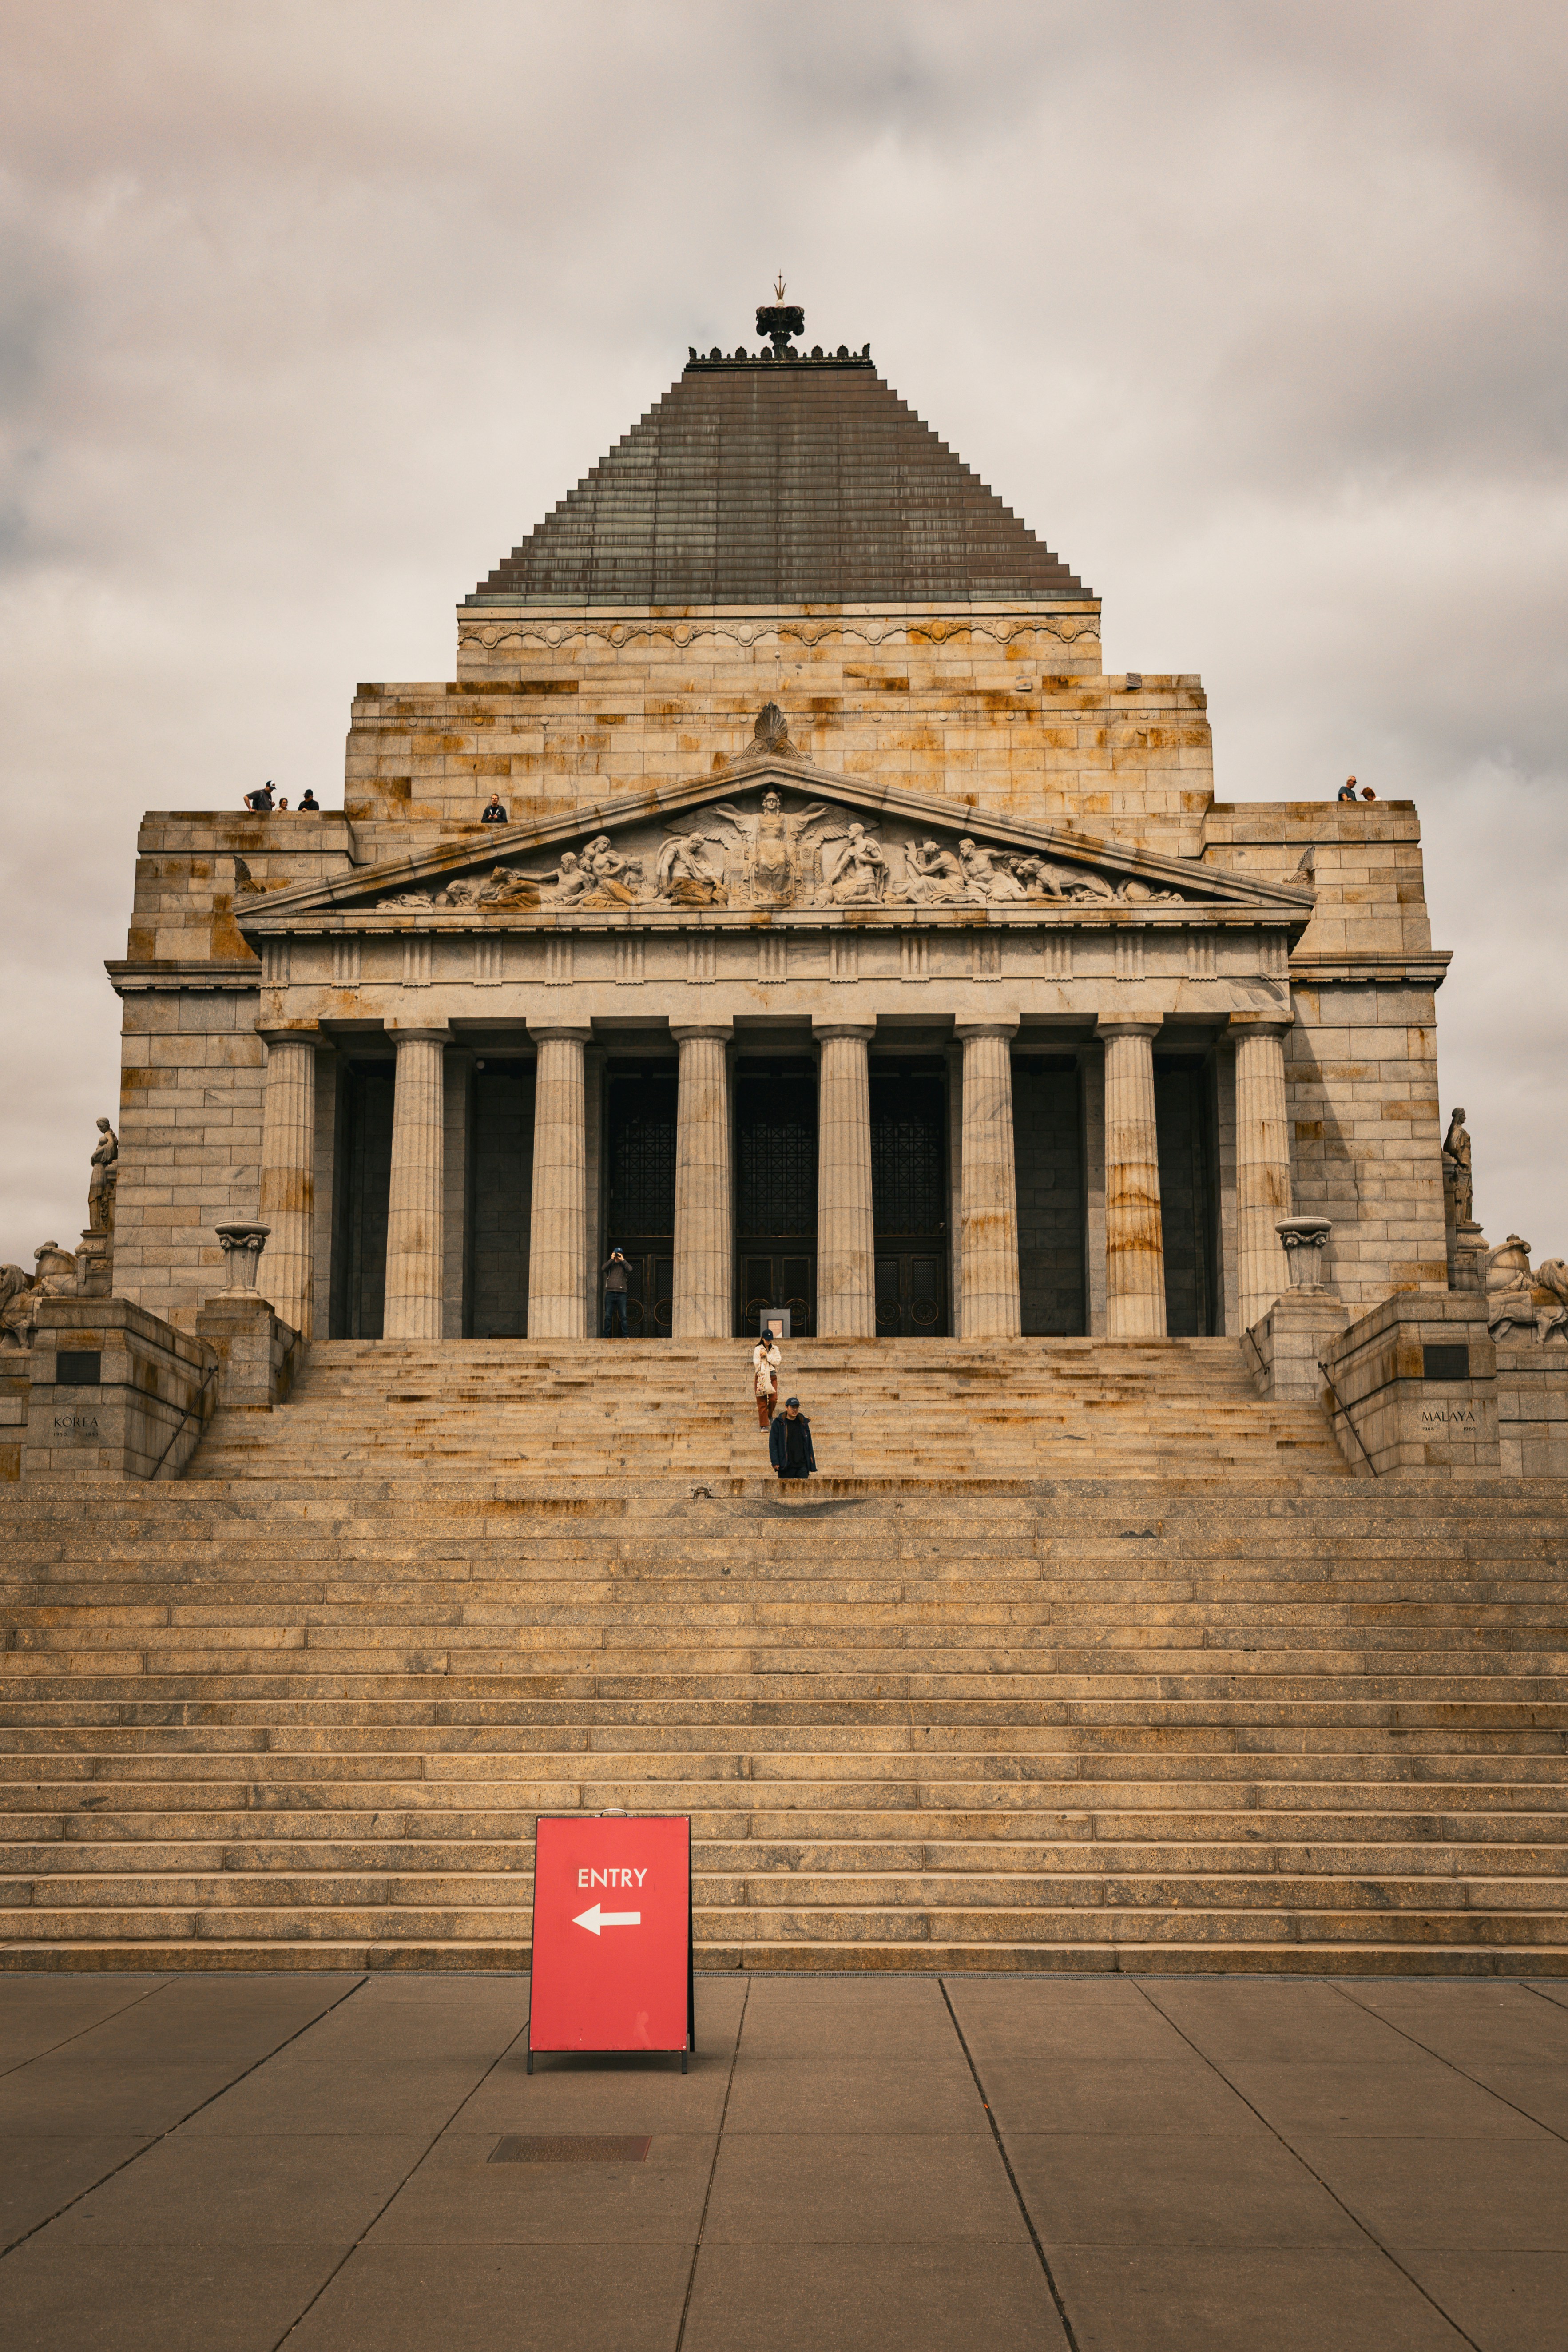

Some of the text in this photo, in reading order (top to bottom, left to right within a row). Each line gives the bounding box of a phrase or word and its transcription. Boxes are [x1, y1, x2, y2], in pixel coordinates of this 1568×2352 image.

[54, 1417, 99, 1427] KOREA
[1421, 1411, 1475, 1422] MALAYA
[578, 1868, 648, 1887] ENTRY
